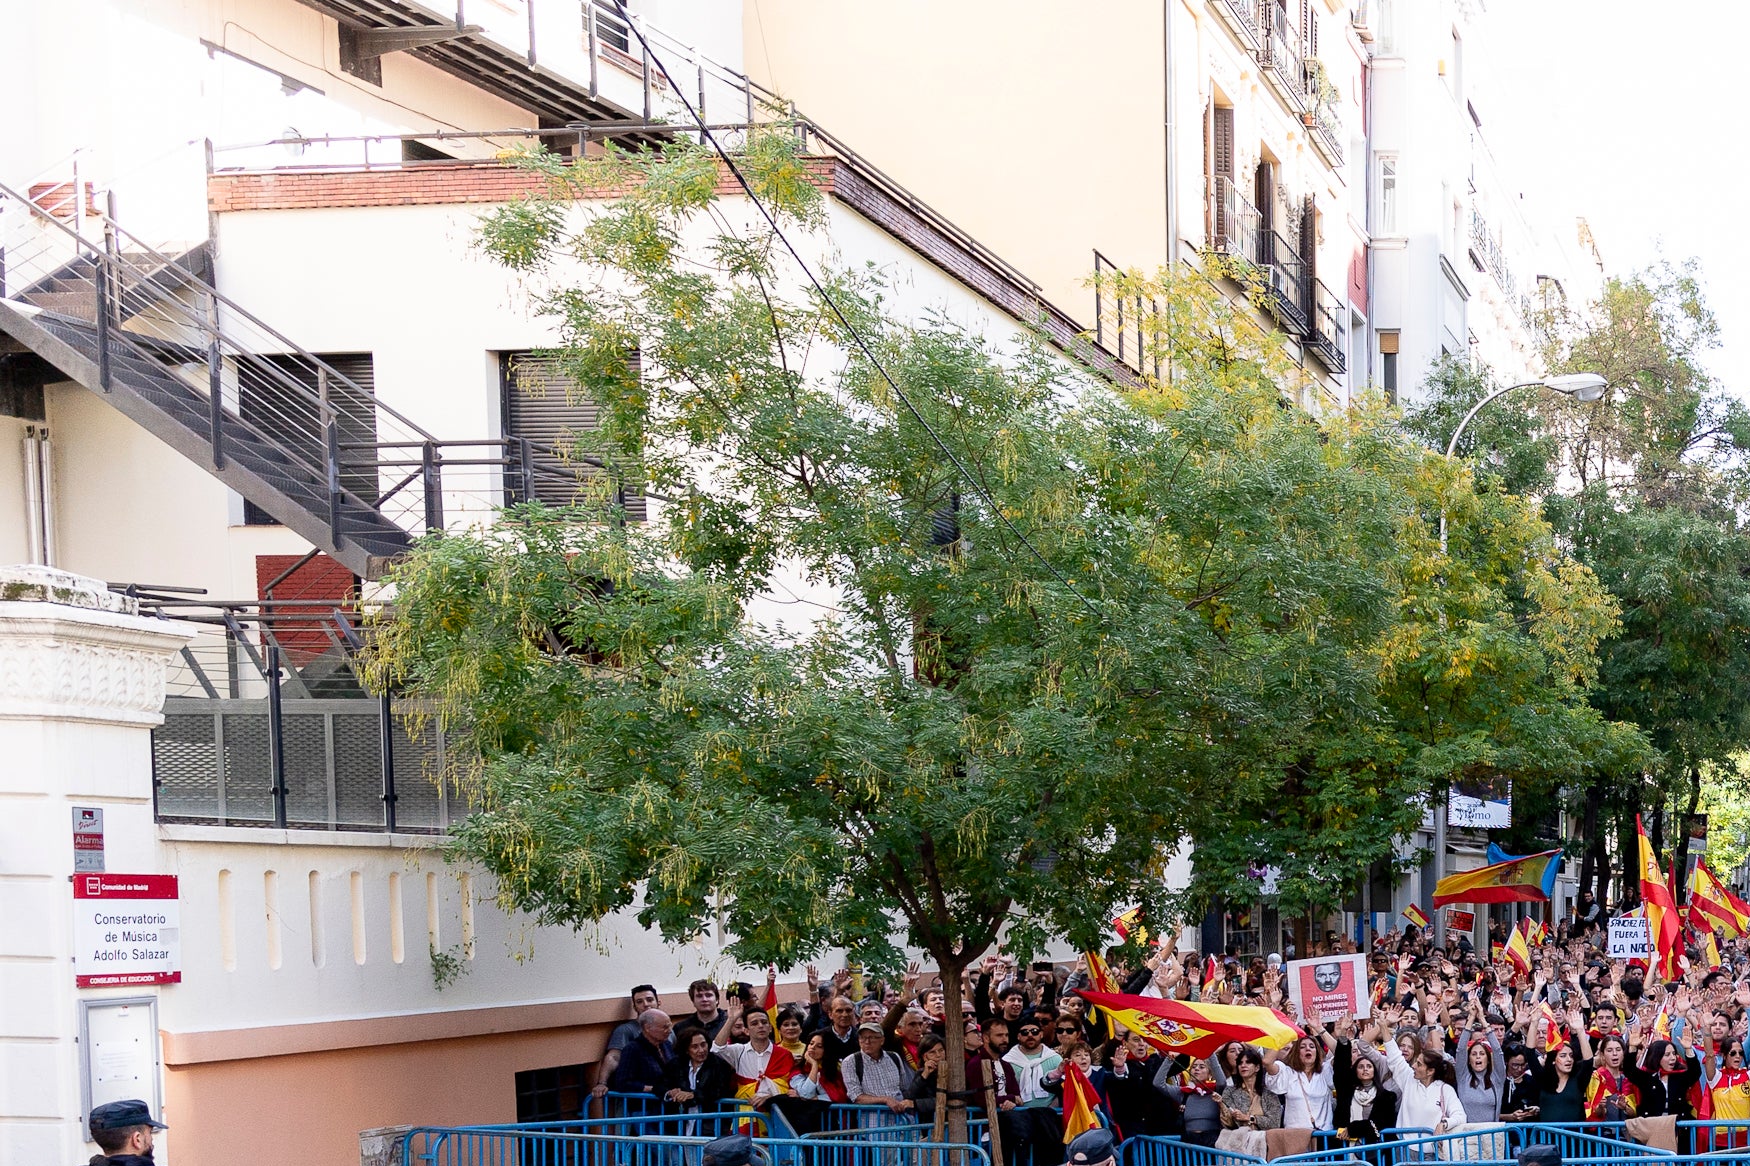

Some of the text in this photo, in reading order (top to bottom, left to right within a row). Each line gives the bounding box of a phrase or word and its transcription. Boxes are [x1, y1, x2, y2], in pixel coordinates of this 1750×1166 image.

[94, 913, 166, 925] Conservatorio
[105, 931, 158, 942] de Música
[1614, 930, 1639, 939] FUERA
[1613, 944, 1625, 954] LA
[94, 948, 169, 961] Adolfo Salazar
[1324, 993, 1348, 1001] MIRES
